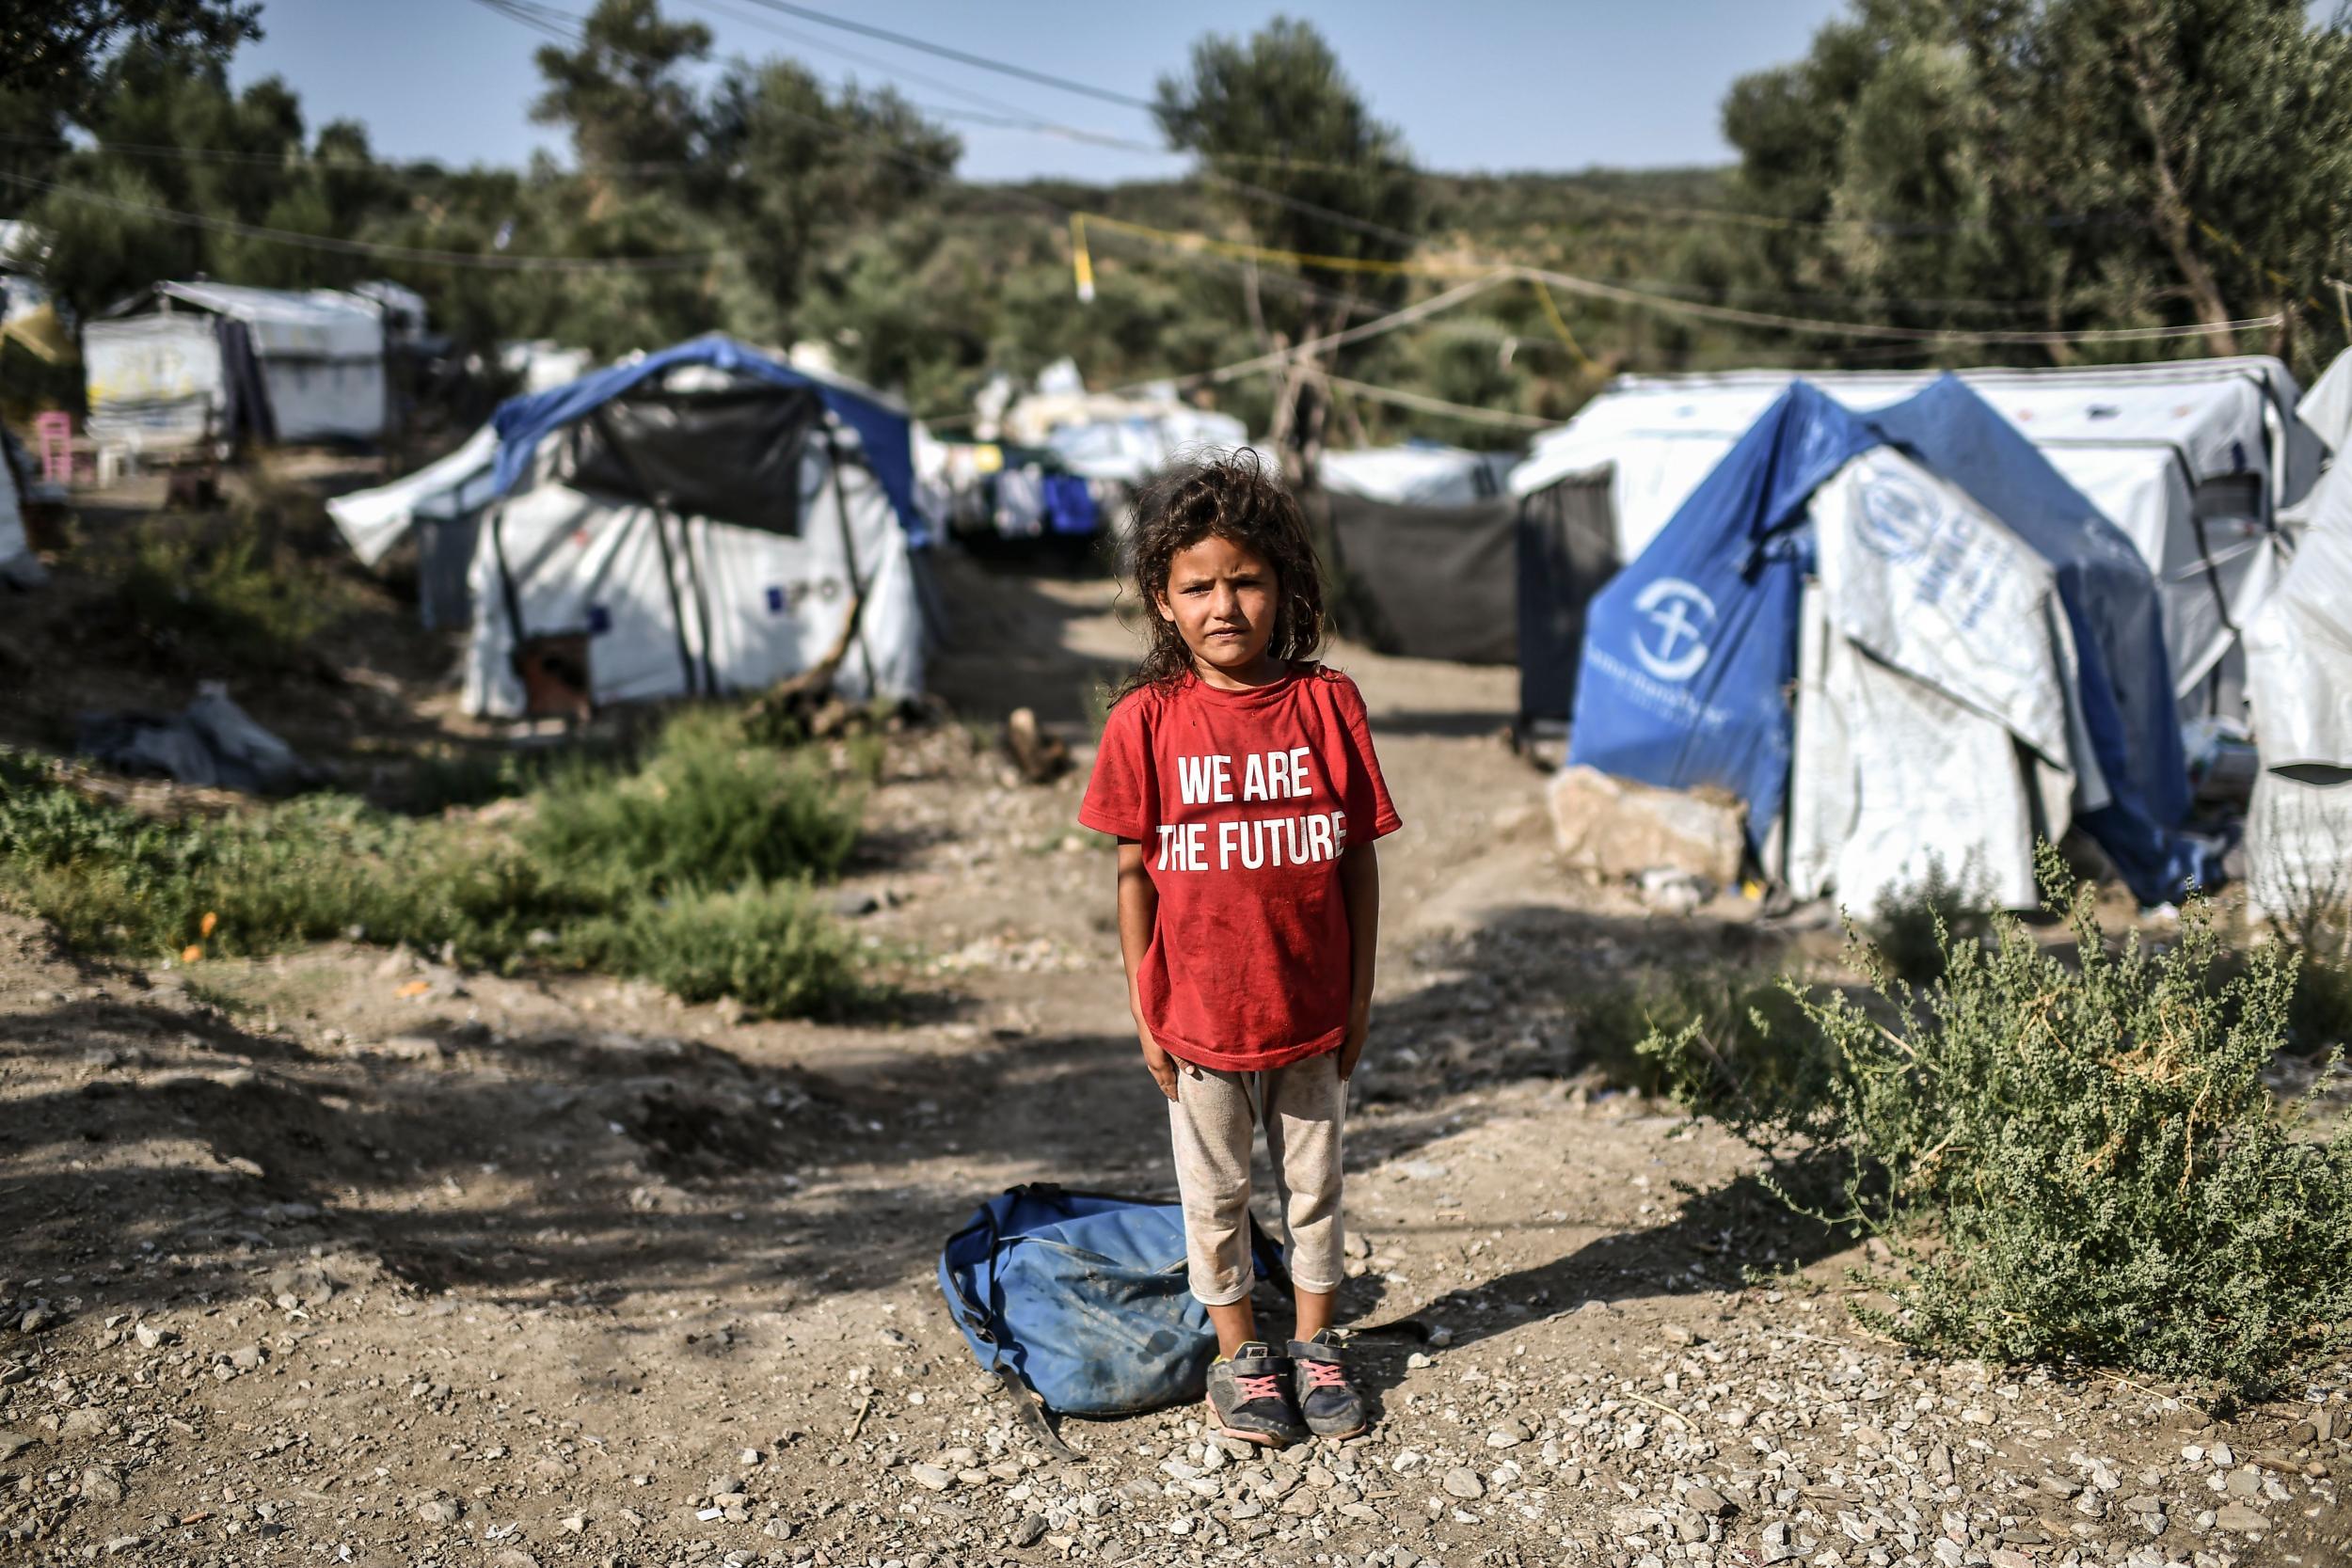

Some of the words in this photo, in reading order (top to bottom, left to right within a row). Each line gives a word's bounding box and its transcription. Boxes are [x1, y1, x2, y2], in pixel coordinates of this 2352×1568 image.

[1177, 754, 1233, 805] WE
[1243, 746, 1312, 801] ARE
[1155, 823, 1209, 872] THE
[1218, 810, 1347, 871] FUTURE
